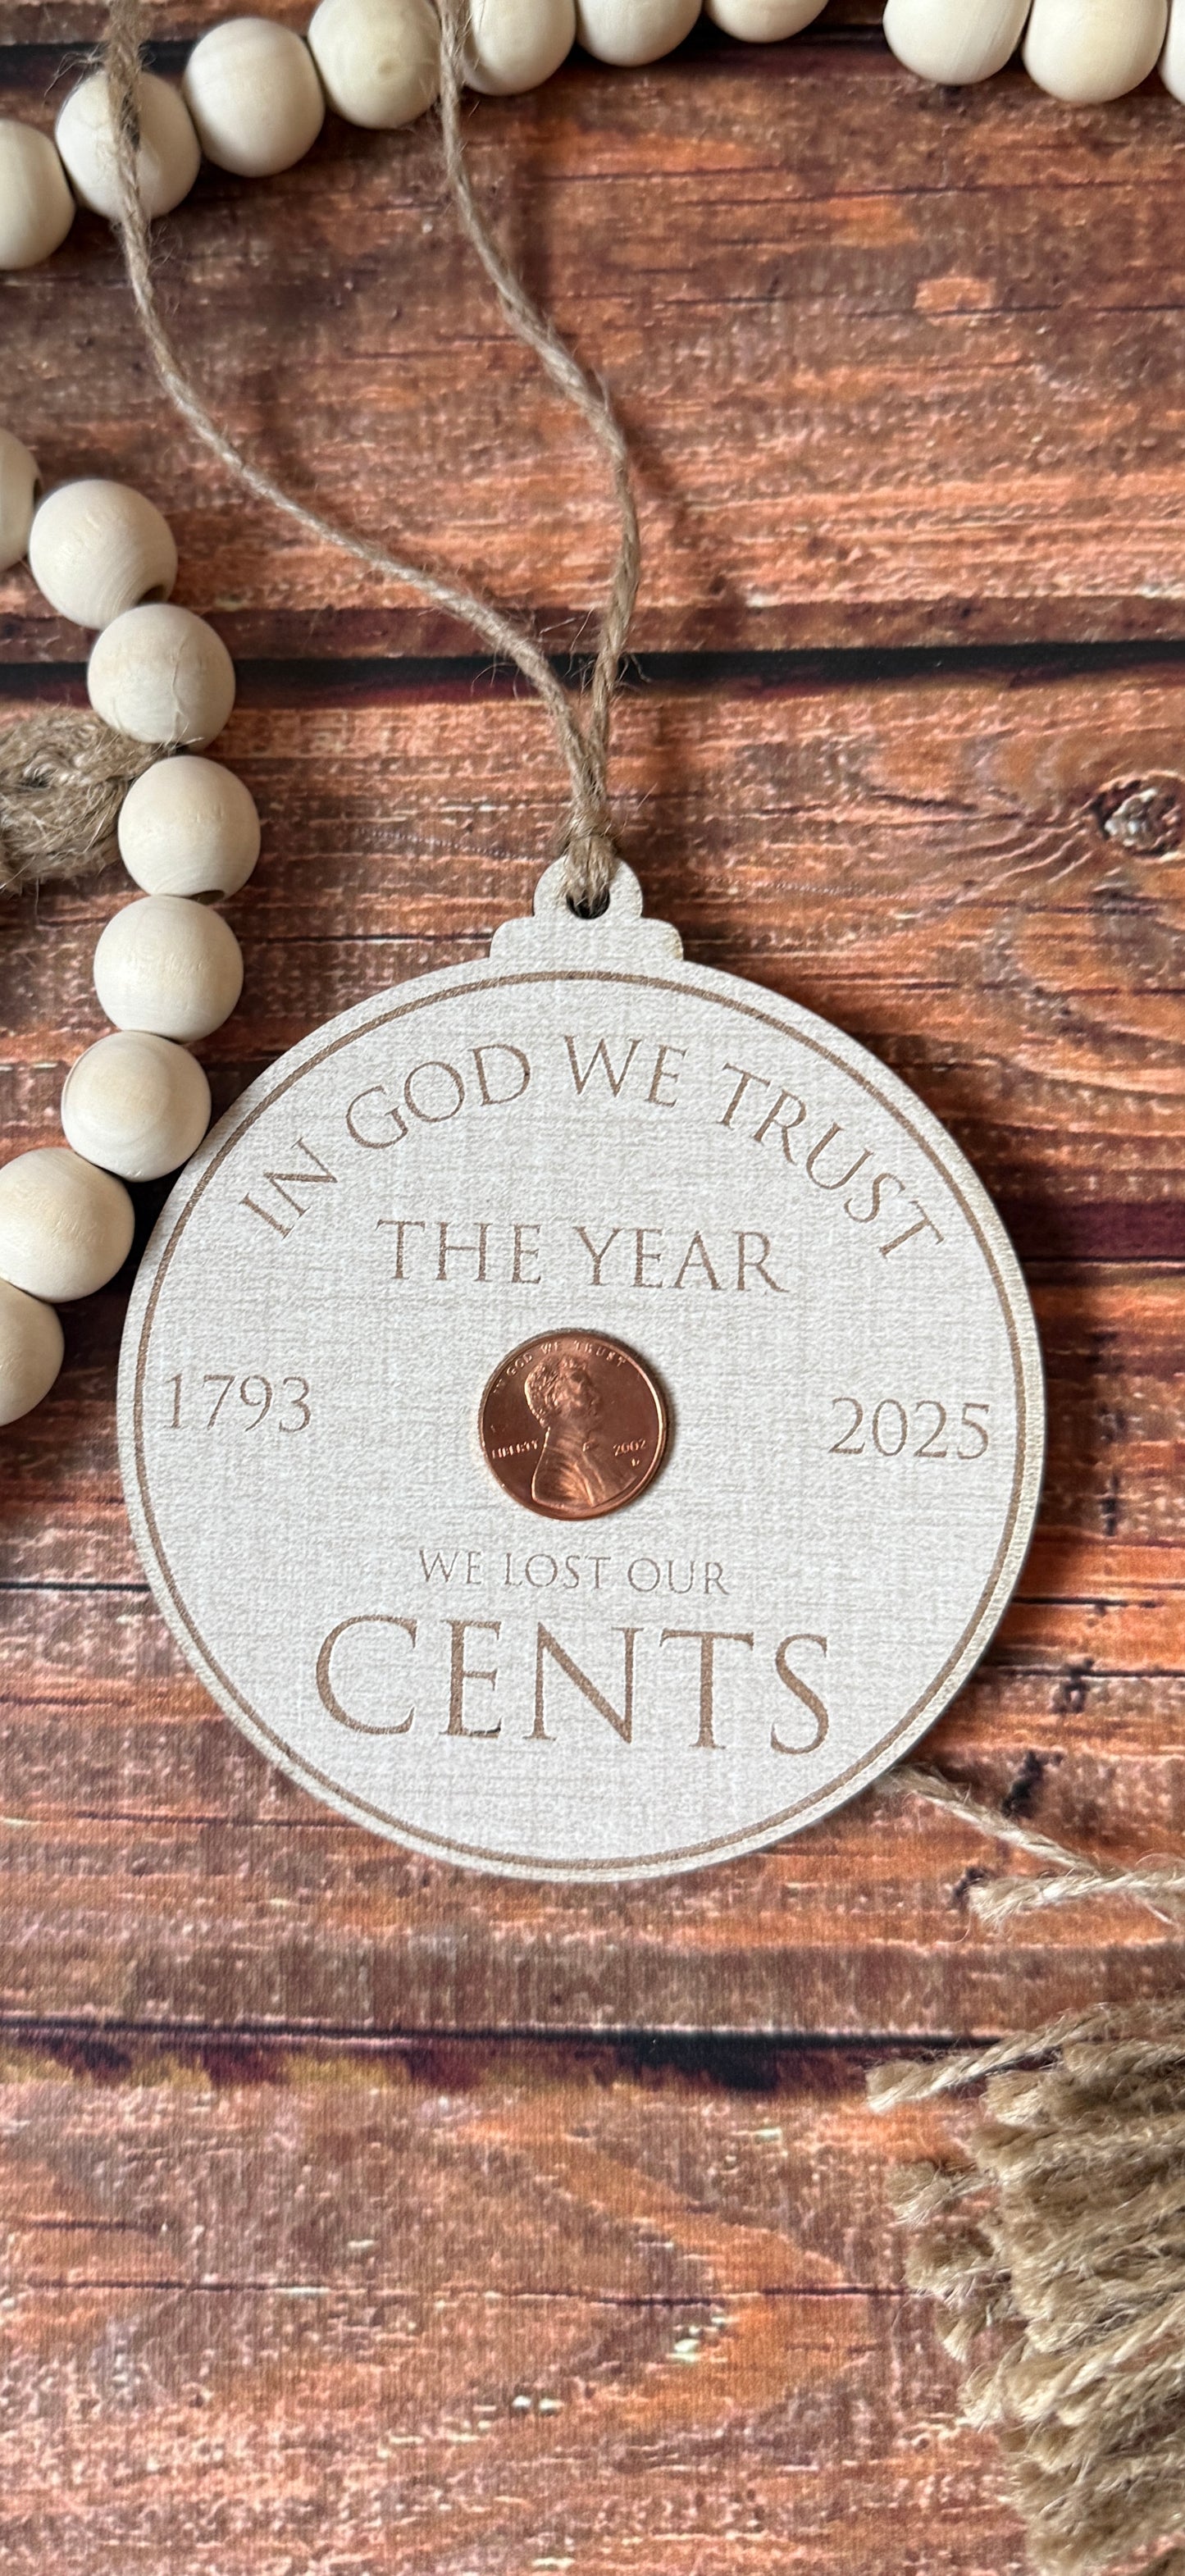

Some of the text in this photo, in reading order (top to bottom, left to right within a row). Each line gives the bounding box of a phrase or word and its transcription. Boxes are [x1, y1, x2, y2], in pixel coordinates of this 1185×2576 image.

[239, 1034, 945, 1260] IN GOD WE TRUST
[376, 1218, 789, 1293] THE YEAR
[506, 1353, 532, 1376] GOD
[573, 1340, 627, 1368] TRUST
[163, 1371, 312, 1434] 1793
[827, 1397, 991, 1461] 2025
[492, 1438, 538, 1459] LIBERTY
[418, 1548, 731, 1596] WE LOST OUR
[315, 1613, 830, 1756] CENTS
